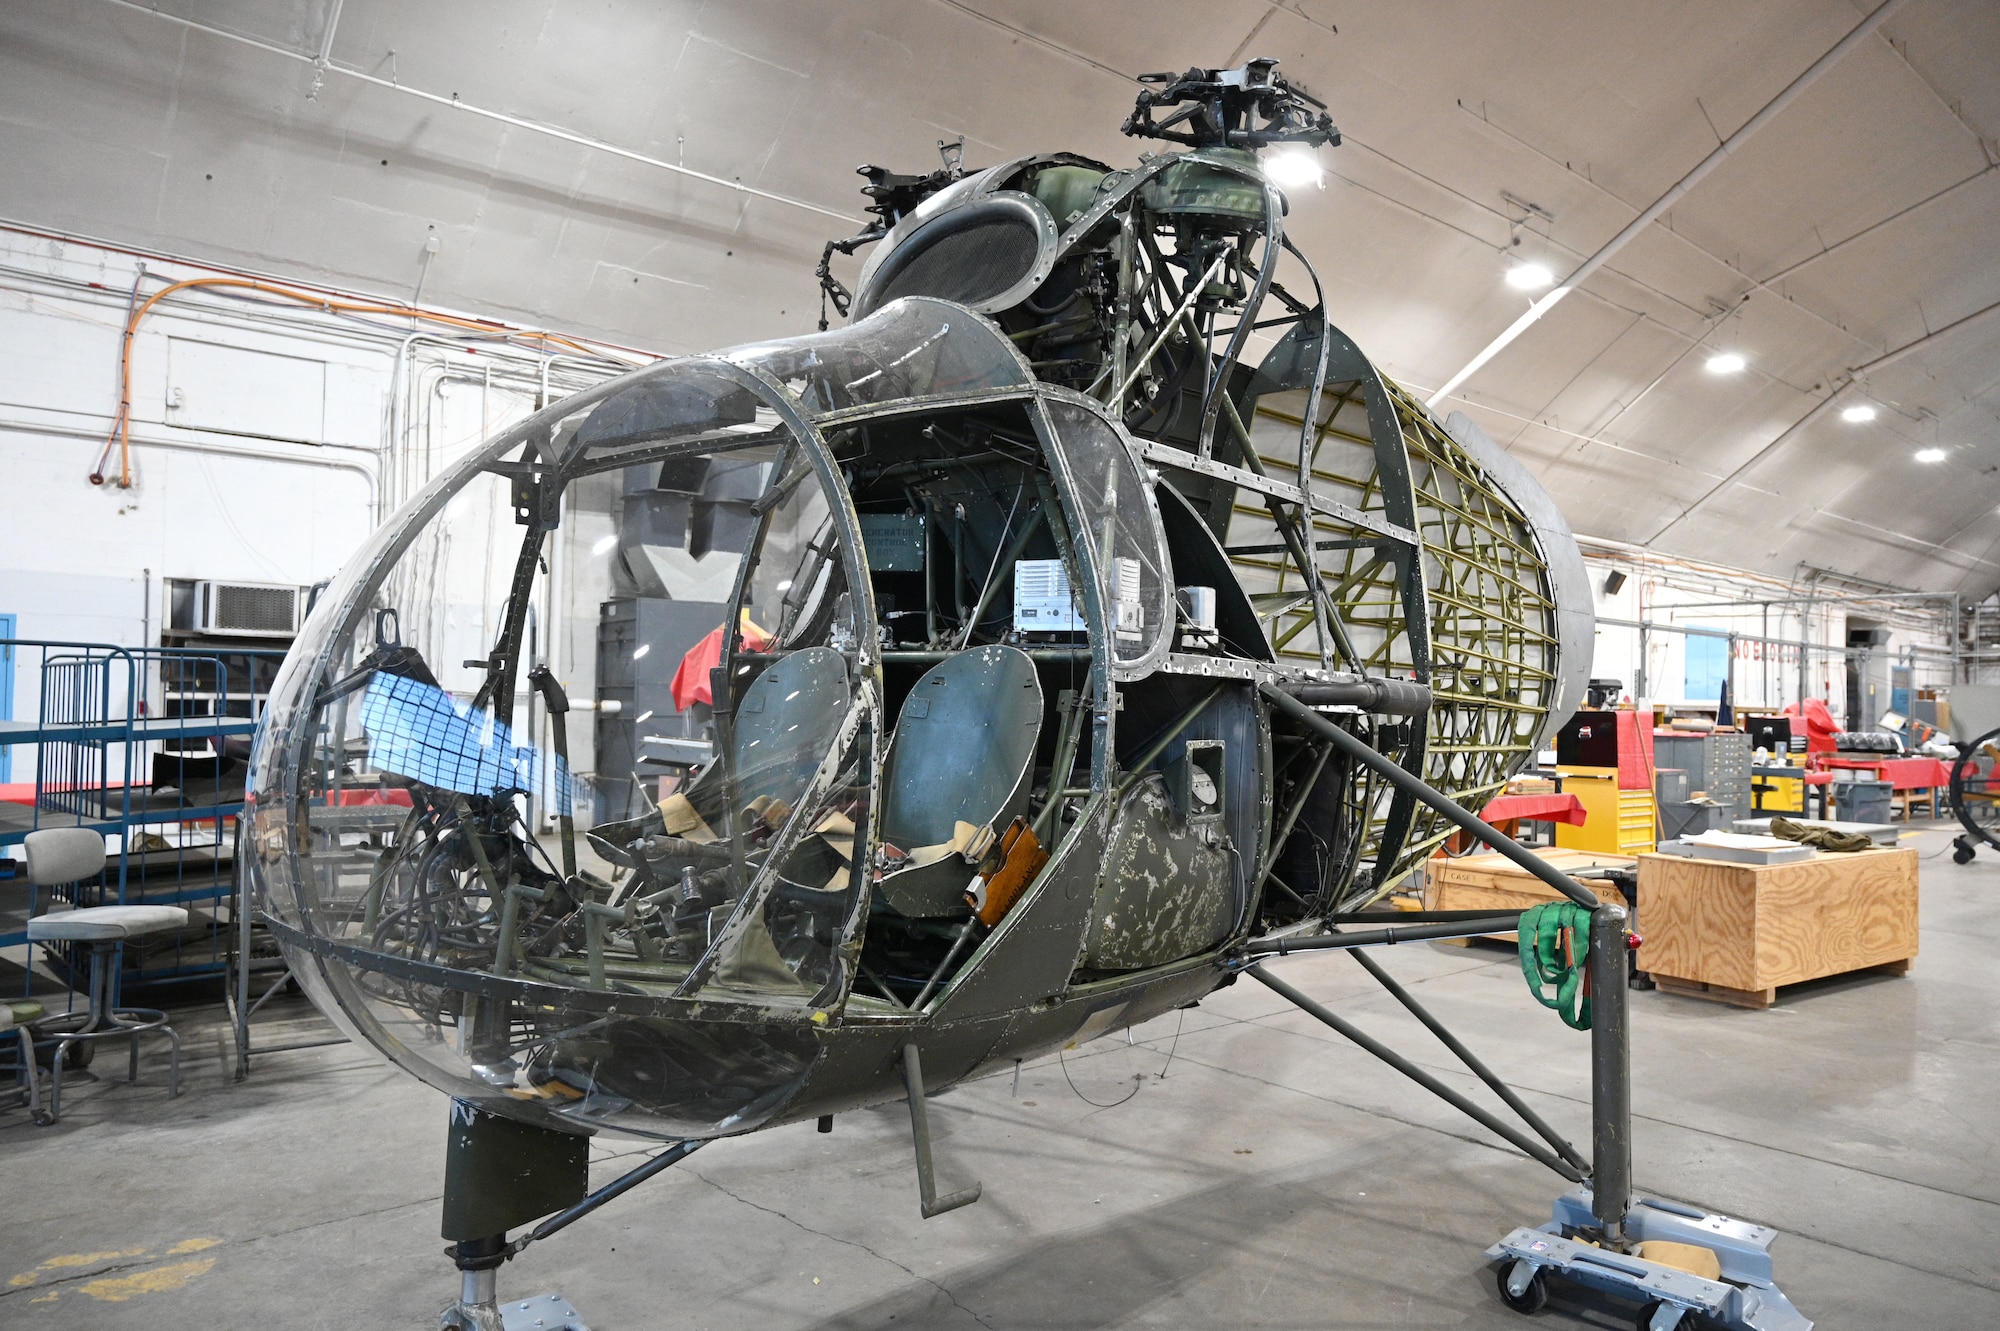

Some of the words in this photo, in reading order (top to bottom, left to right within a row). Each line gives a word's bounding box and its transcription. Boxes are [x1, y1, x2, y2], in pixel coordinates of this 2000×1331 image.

[865, 538, 908, 546] CONTROL
[1735, 639, 1749, 660] NO
[1753, 641, 1801, 664] SOKIN
[1450, 872, 1471, 881] CASE
